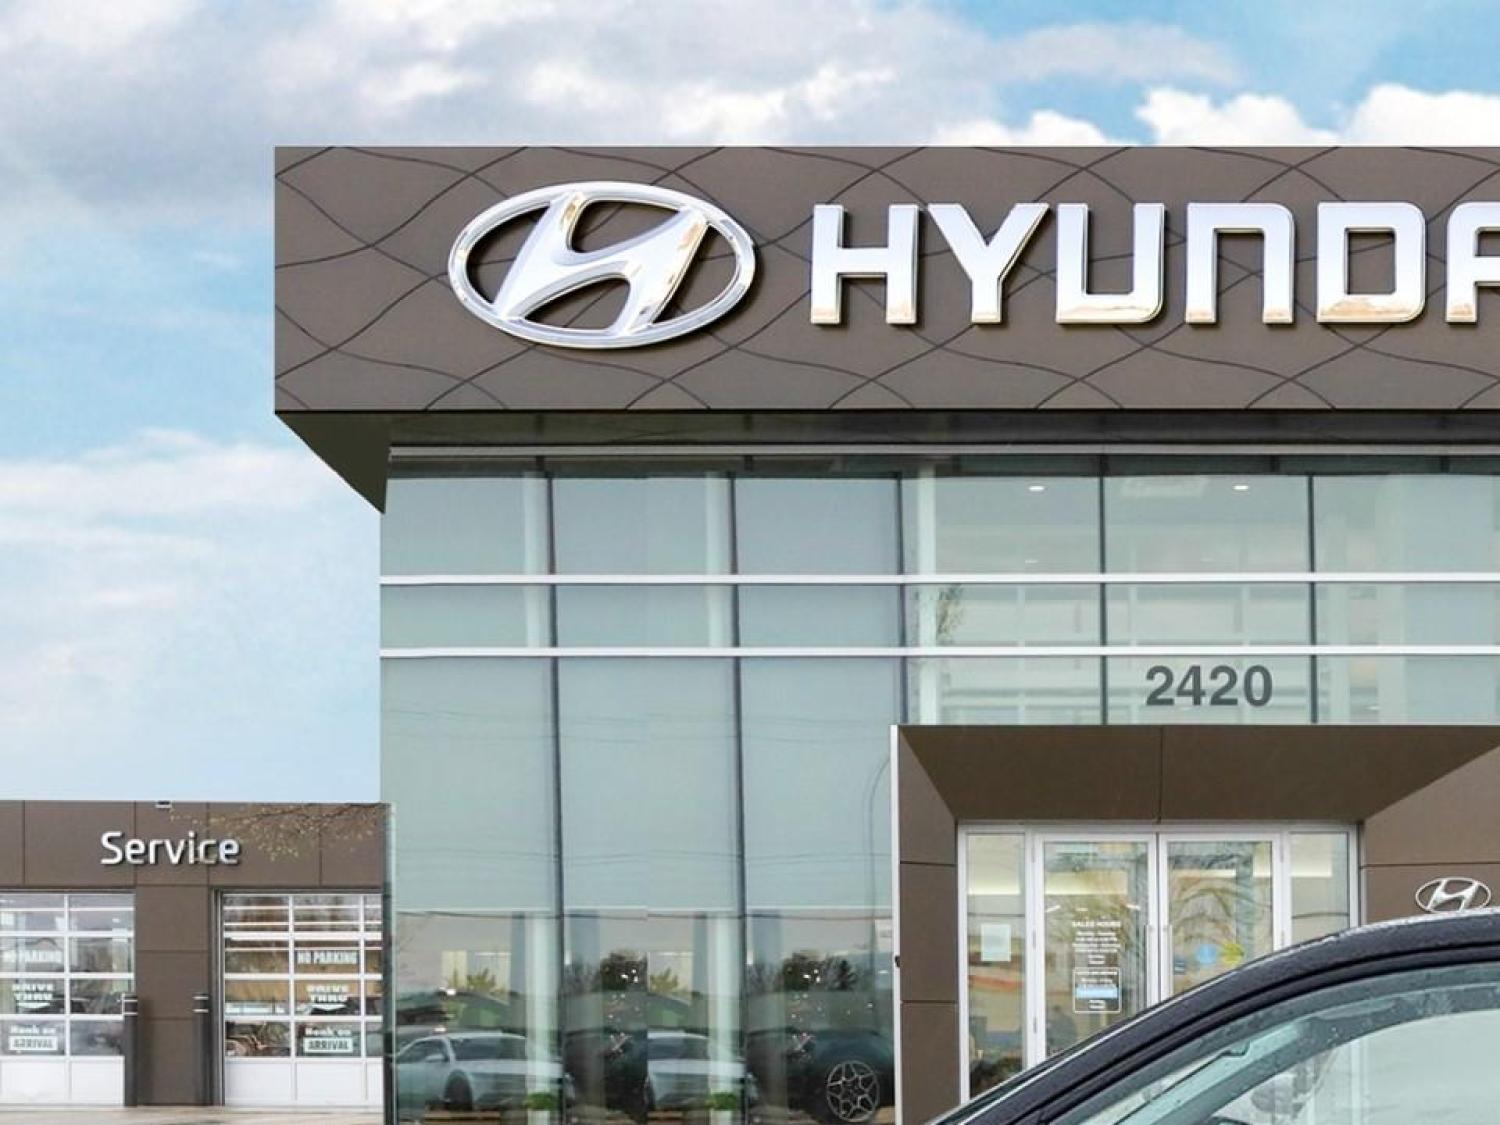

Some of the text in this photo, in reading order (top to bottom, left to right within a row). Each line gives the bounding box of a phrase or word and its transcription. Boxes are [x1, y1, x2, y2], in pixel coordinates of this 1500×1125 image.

[1145, 664, 1273, 707] 2420
[100, 830, 240, 865] Service
[308, 1040, 349, 1050] ARRIVAL
